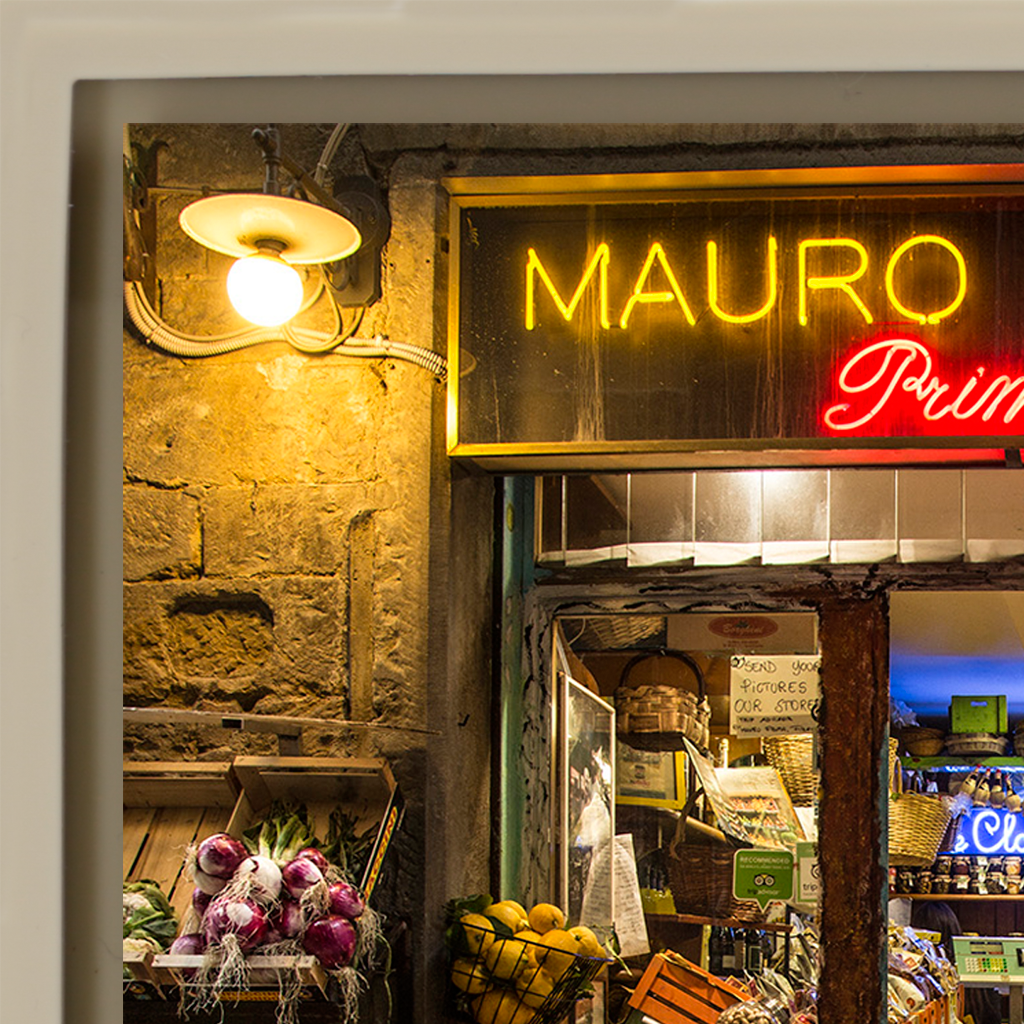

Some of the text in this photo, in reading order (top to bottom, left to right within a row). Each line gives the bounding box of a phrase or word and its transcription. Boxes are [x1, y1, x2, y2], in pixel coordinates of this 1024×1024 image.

[525, 234, 968, 330] MAURO
[744, 660, 777, 673] SEND
[734, 699, 762, 713] OUR
